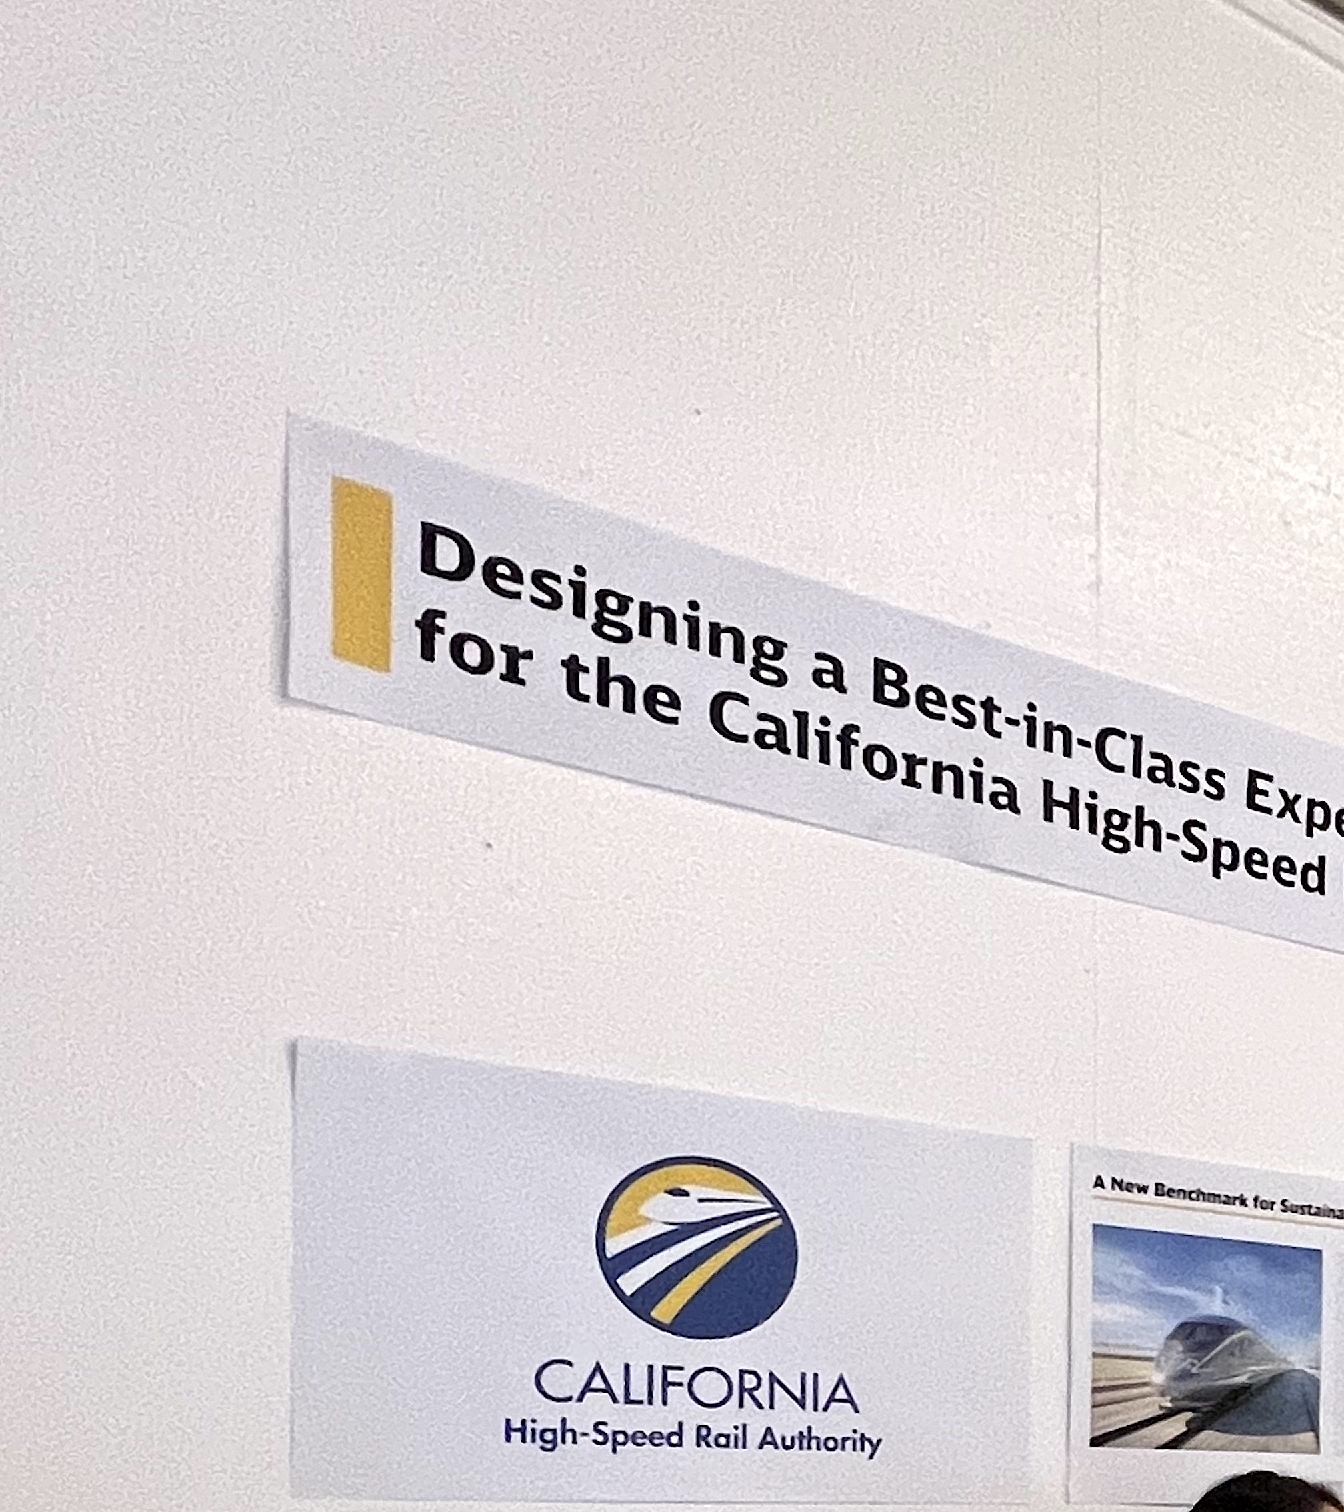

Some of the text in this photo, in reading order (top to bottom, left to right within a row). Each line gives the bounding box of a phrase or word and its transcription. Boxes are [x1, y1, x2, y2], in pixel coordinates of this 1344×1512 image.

[418, 520, 788, 687] Designing
[812, 646, 849, 693] a
[871, 657, 1227, 801] Best-in-Class
[415, 609, 533, 687] for
[563, 656, 683, 725] the
[709, 689, 1022, 815] California
[1040, 779, 1327, 896] High-Speed
[1093, 1174, 1105, 1189] A
[1111, 1177, 1149, 1195] New
[1154, 1182, 1248, 1208] Benchmark
[1253, 1195, 1276, 1212] for
[534, 1358, 860, 1413] CALIFORNIA
[504, 1418, 882, 1460] High-Speed Rail Authority
